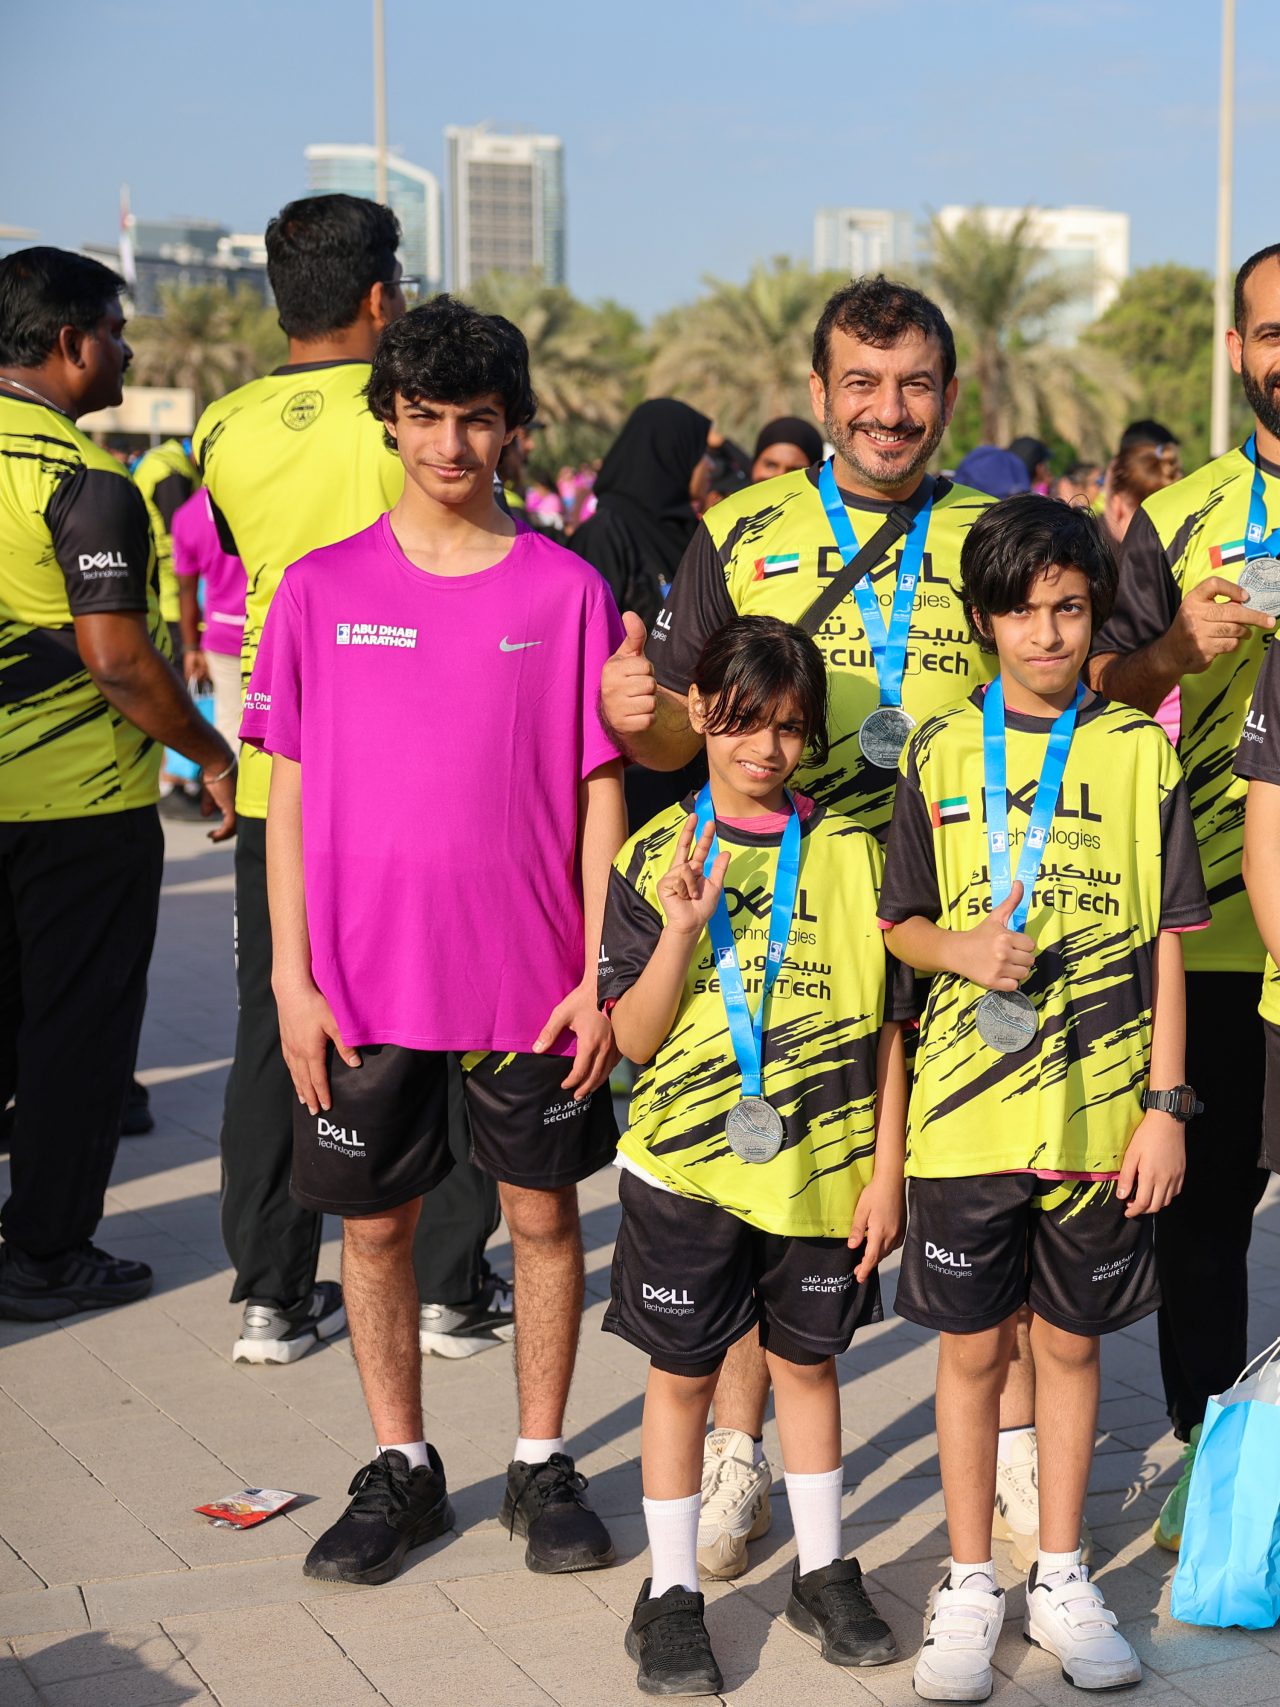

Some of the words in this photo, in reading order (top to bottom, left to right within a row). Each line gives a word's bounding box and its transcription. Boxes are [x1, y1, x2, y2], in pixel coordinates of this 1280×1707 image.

[79, 551, 128, 571] DELL
[656, 608, 673, 630] LL
[351, 635, 417, 648] MARATHON
[352, 624, 378, 634] ABU
[379, 625, 418, 639] DHABI
[1245, 710, 1267, 733] LL
[723, 885, 818, 923] DEL
[317, 1117, 366, 1147] DELL
[925, 1240, 973, 1267] DELL
[925, 1258, 973, 1279] Technologies
[642, 1282, 695, 1304] DELL
[642, 1300, 696, 1317] Technologies
